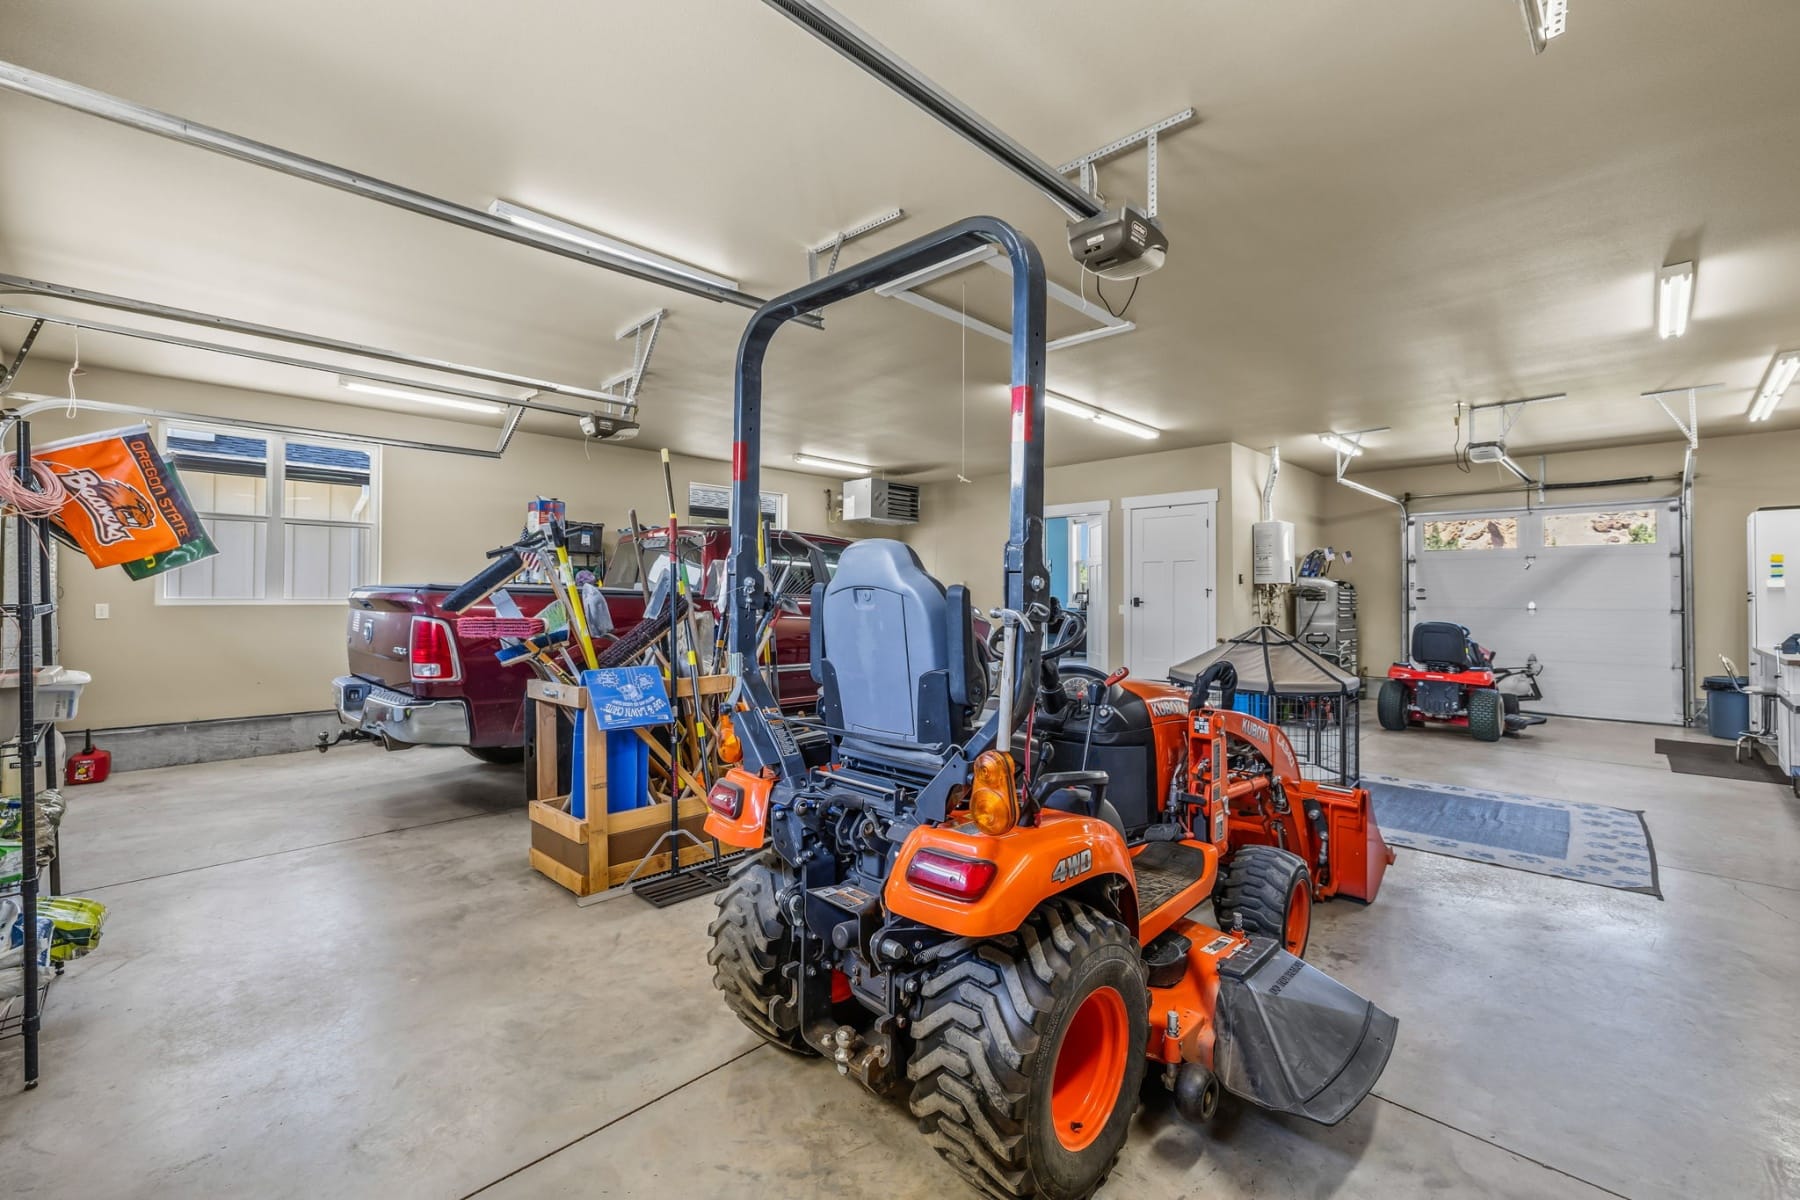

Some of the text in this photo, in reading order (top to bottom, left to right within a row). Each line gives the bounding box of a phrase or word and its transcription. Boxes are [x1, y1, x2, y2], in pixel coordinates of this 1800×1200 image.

[131, 440, 190, 538] OREGON STATE
[1150, 702, 1189, 717] KUBOTA
[1241, 718, 1269, 743] KUBOTA
[1052, 849, 1092, 882] 4WD
